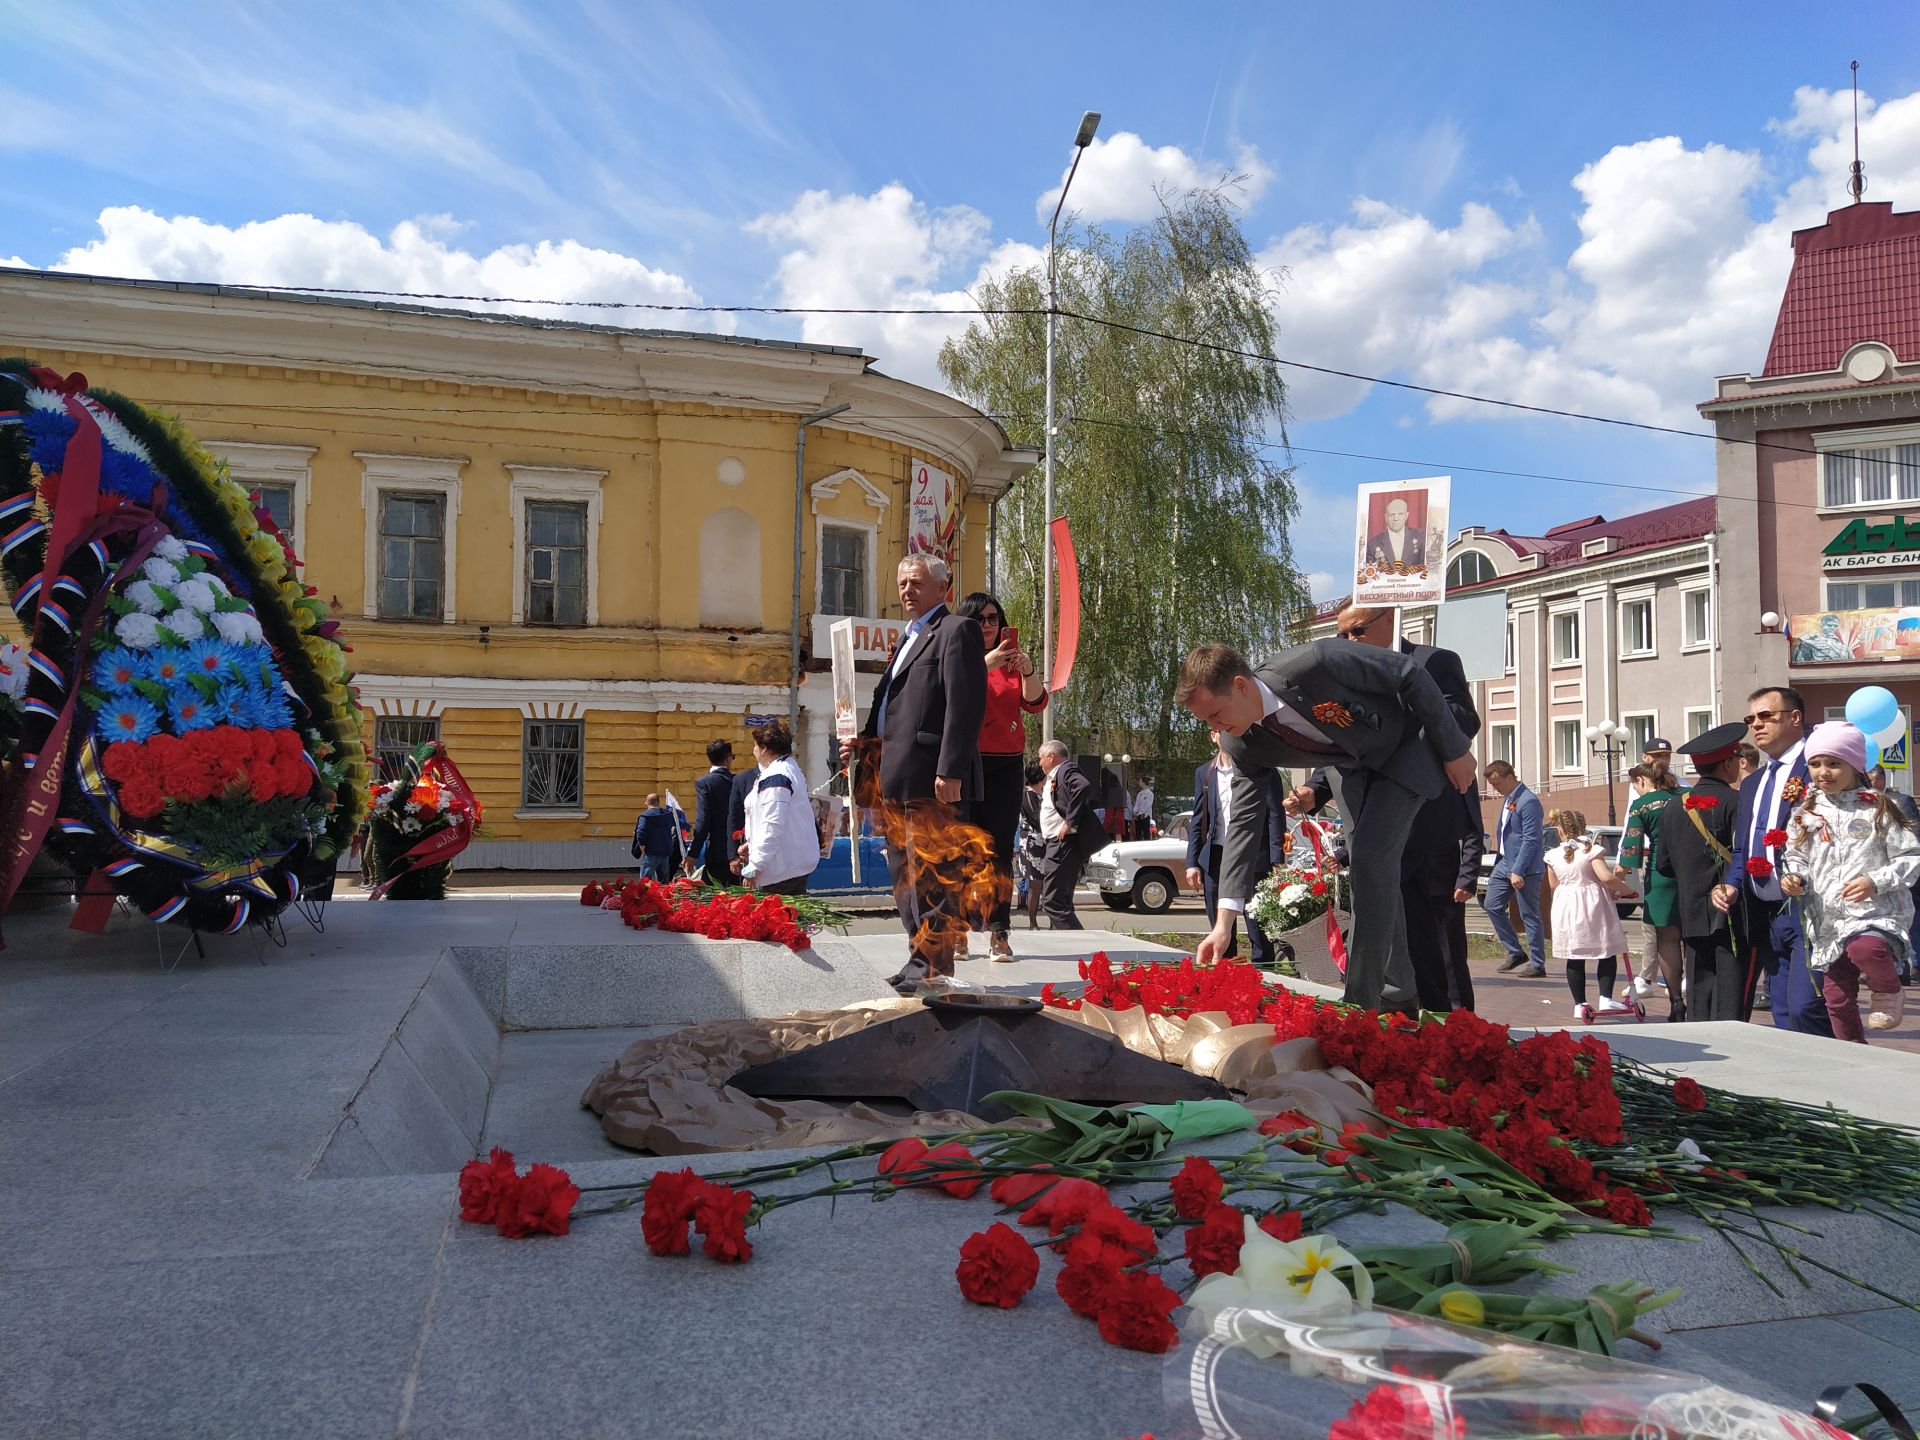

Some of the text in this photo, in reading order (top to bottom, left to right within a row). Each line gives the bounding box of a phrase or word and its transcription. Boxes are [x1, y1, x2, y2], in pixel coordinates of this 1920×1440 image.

[918, 467, 928, 495] 9
[913, 496, 933, 506] мая
[1823, 558, 1842, 568] АК
[1847, 555, 1886, 566] БАРС
[1360, 591, 1414, 600] БЕССМЕРТНЫЙ
